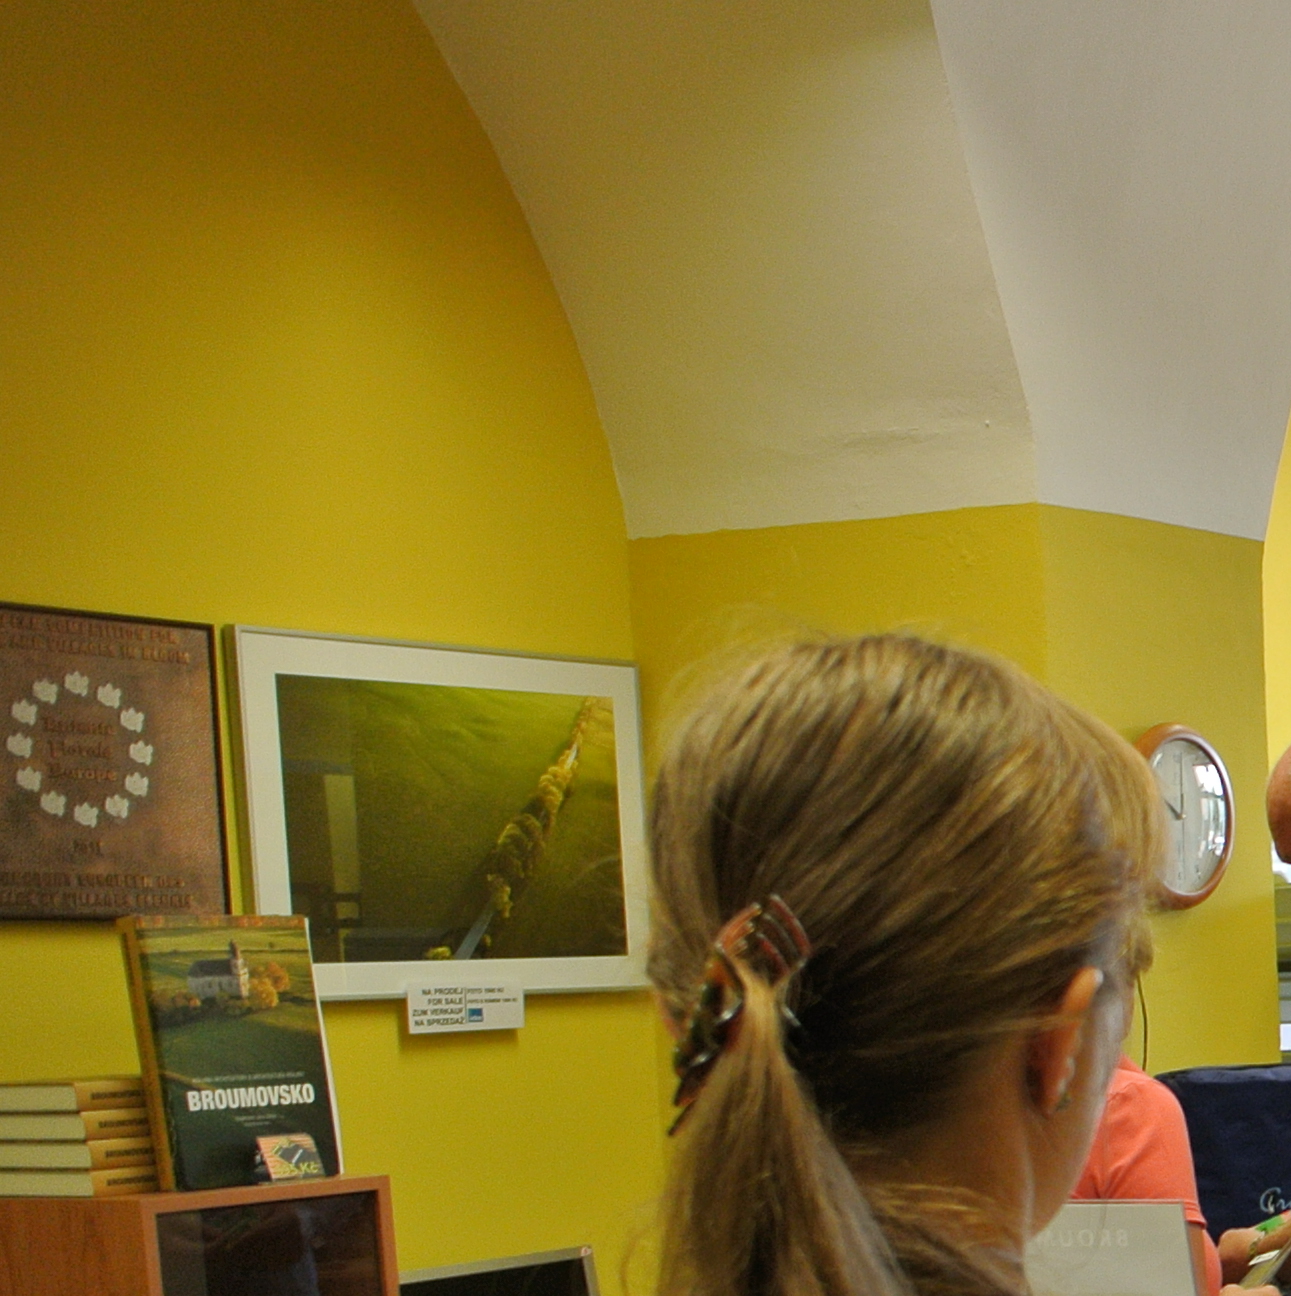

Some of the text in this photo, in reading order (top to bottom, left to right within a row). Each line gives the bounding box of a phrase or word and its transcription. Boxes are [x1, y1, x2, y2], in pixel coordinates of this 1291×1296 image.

[434, 987, 464, 996] PRODEJ
[428, 997, 463, 1006] FOR SALE
[430, 1007, 464, 1016] VERKAUF
[186, 1083, 316, 1112] BROUMOVSKO
